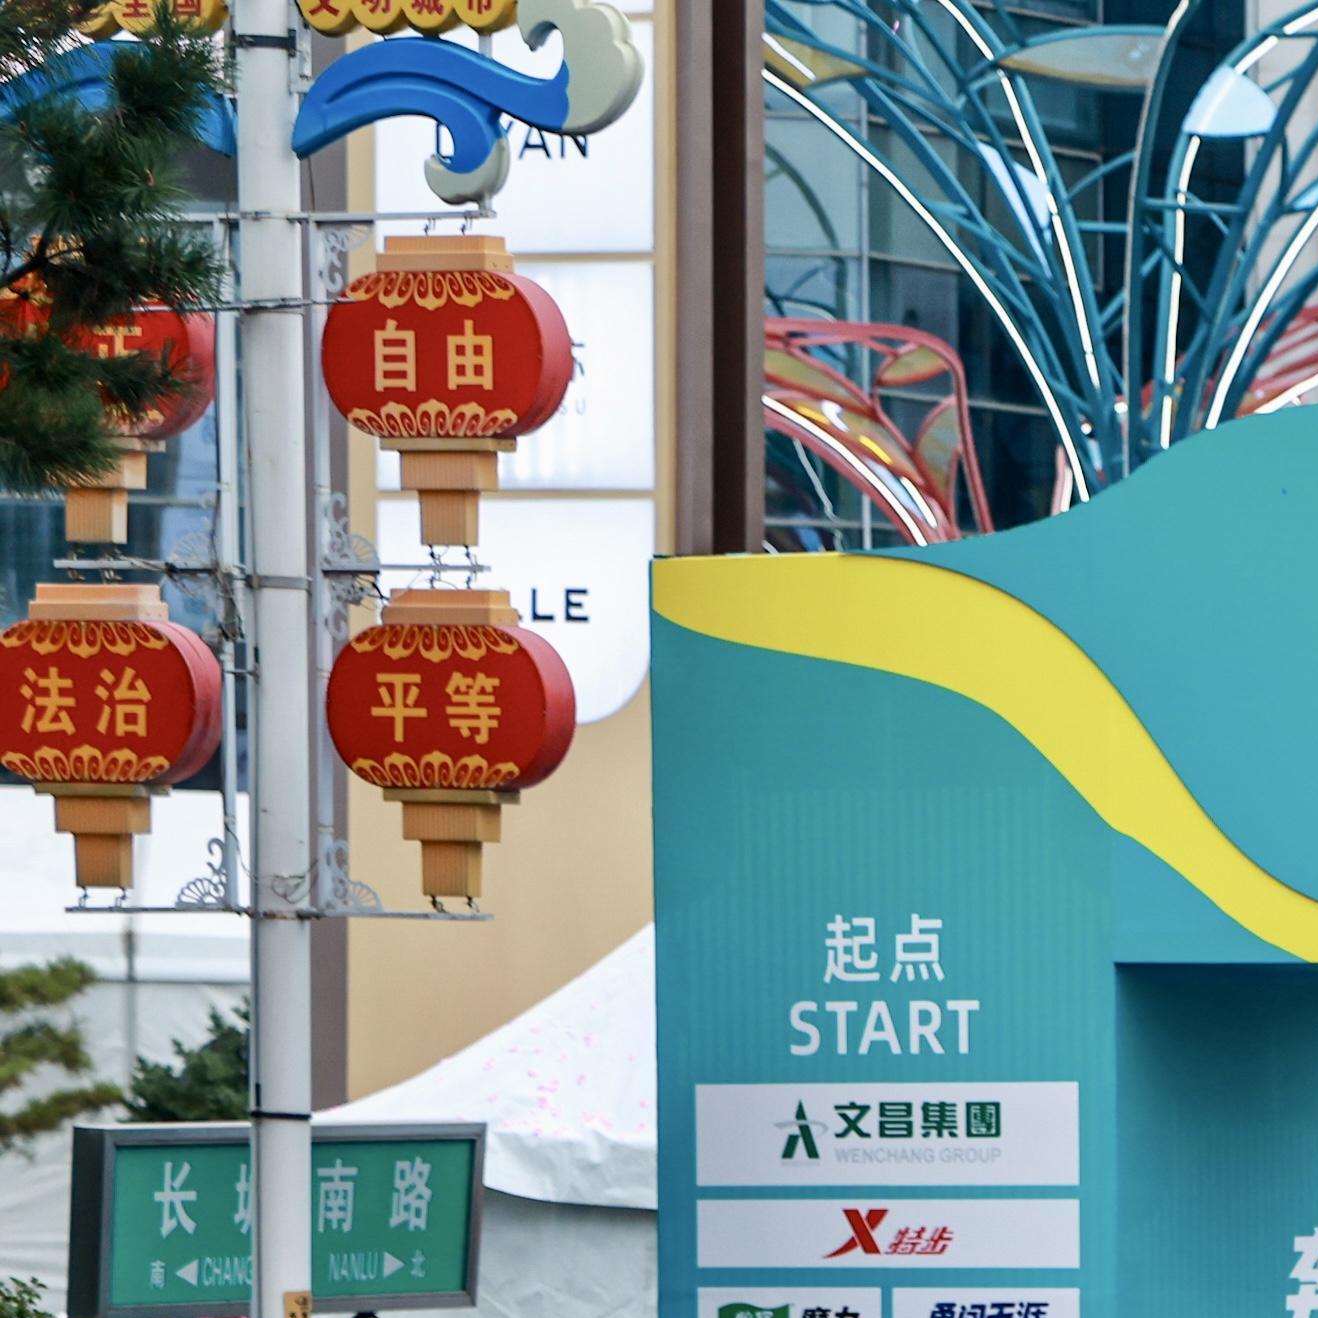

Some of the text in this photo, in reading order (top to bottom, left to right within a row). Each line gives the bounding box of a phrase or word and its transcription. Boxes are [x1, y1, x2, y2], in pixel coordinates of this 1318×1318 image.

[373, 319, 495, 392] 自由
[19, 666, 152, 738] 法治
[370, 671, 502, 744] 平等
[823, 913, 945, 984] 起点
[788, 999, 980, 1056] START
[834, 1147, 936, 1164] WENCHANG
[939, 1147, 1003, 1163] GROUP
[328, 1251, 379, 1281] NANLU
